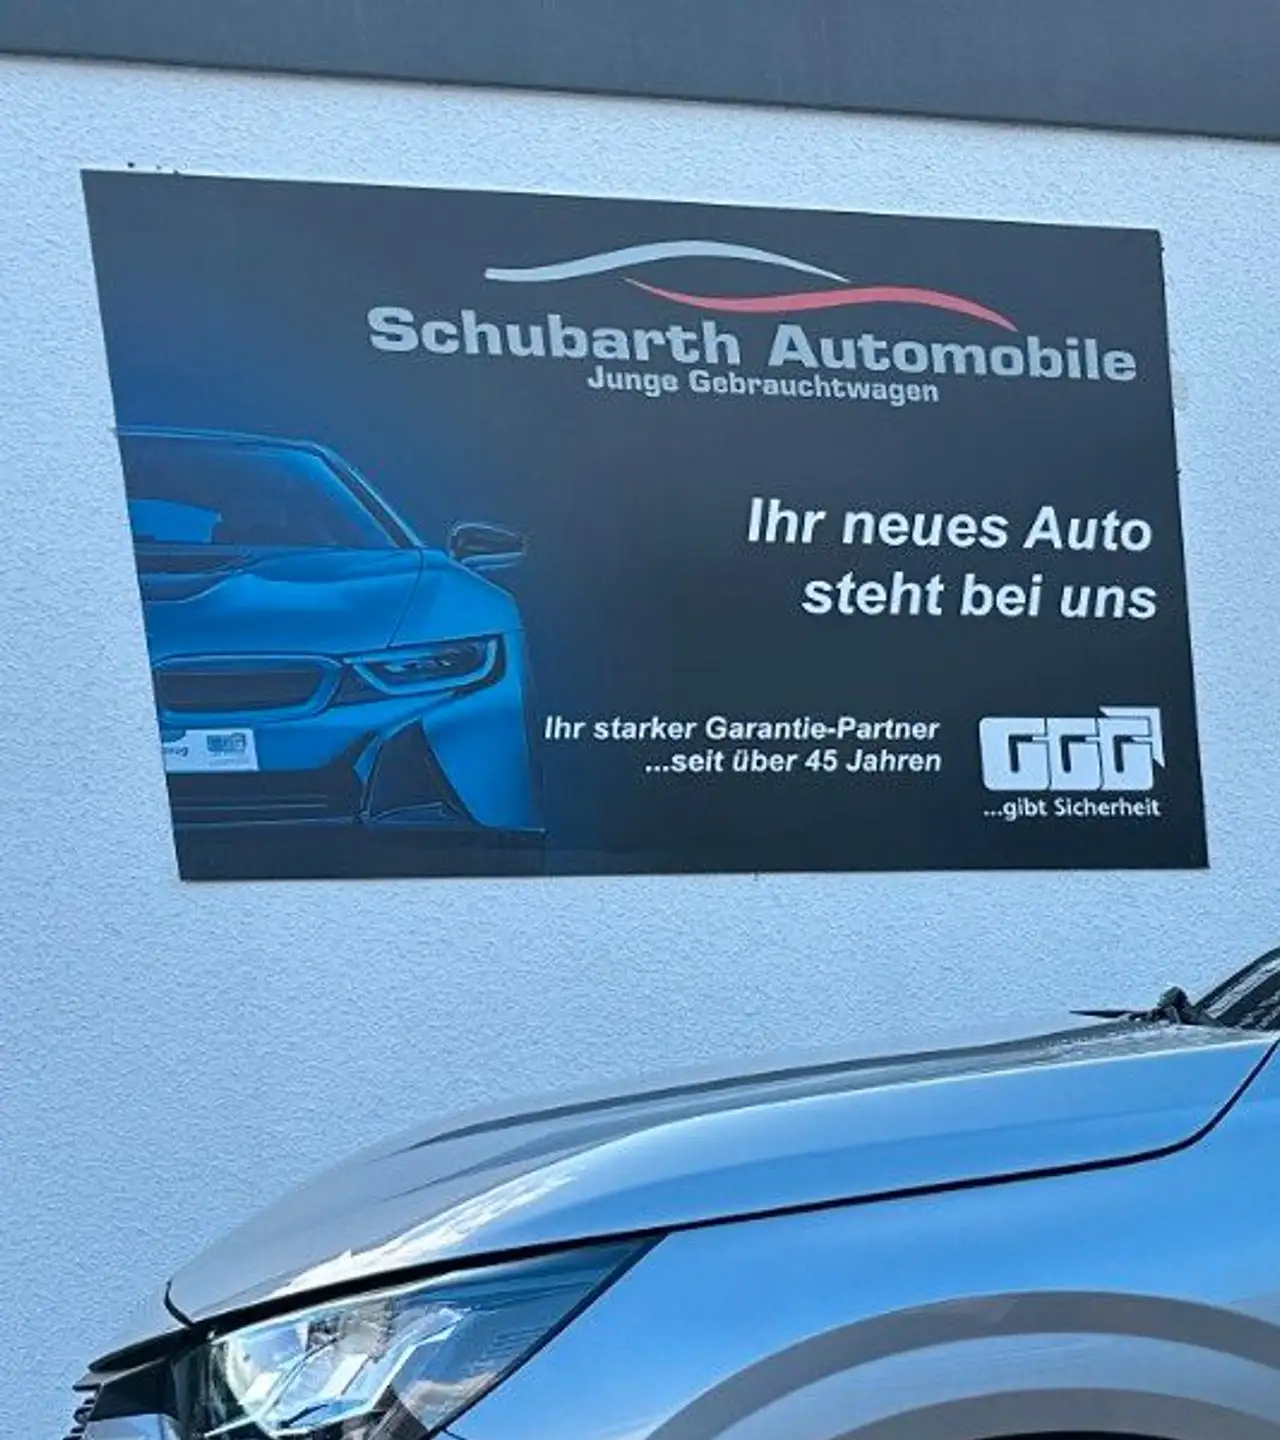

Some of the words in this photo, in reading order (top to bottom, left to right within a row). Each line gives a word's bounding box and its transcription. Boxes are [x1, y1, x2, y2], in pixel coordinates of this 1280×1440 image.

[368, 307, 740, 365] Schubarth
[768, 324, 1136, 381] Automobile
[587, 365, 679, 397] Junge
[689, 370, 938, 406] Gebrauchtwagen
[749, 498, 826, 543] Ihr
[843, 512, 1008, 548] neues
[1023, 506, 1151, 551] Auto
[802, 571, 944, 615] steht
[961, 573, 1042, 616] bei
[1061, 586, 1156, 619] uns
[545, 716, 586, 739] Ihr
[594, 716, 697, 739] starker
[706, 716, 940, 740] Garantie-Partner
[646, 749, 724, 772] ...seit
[733, 749, 798, 772] über
[805, 749, 837, 771] 45
[846, 749, 941, 771] Jahren
[979, 717, 1153, 790] GGG
[984, 797, 1048, 821] ...gibt
[1054, 797, 1160, 816] Sicherheit
